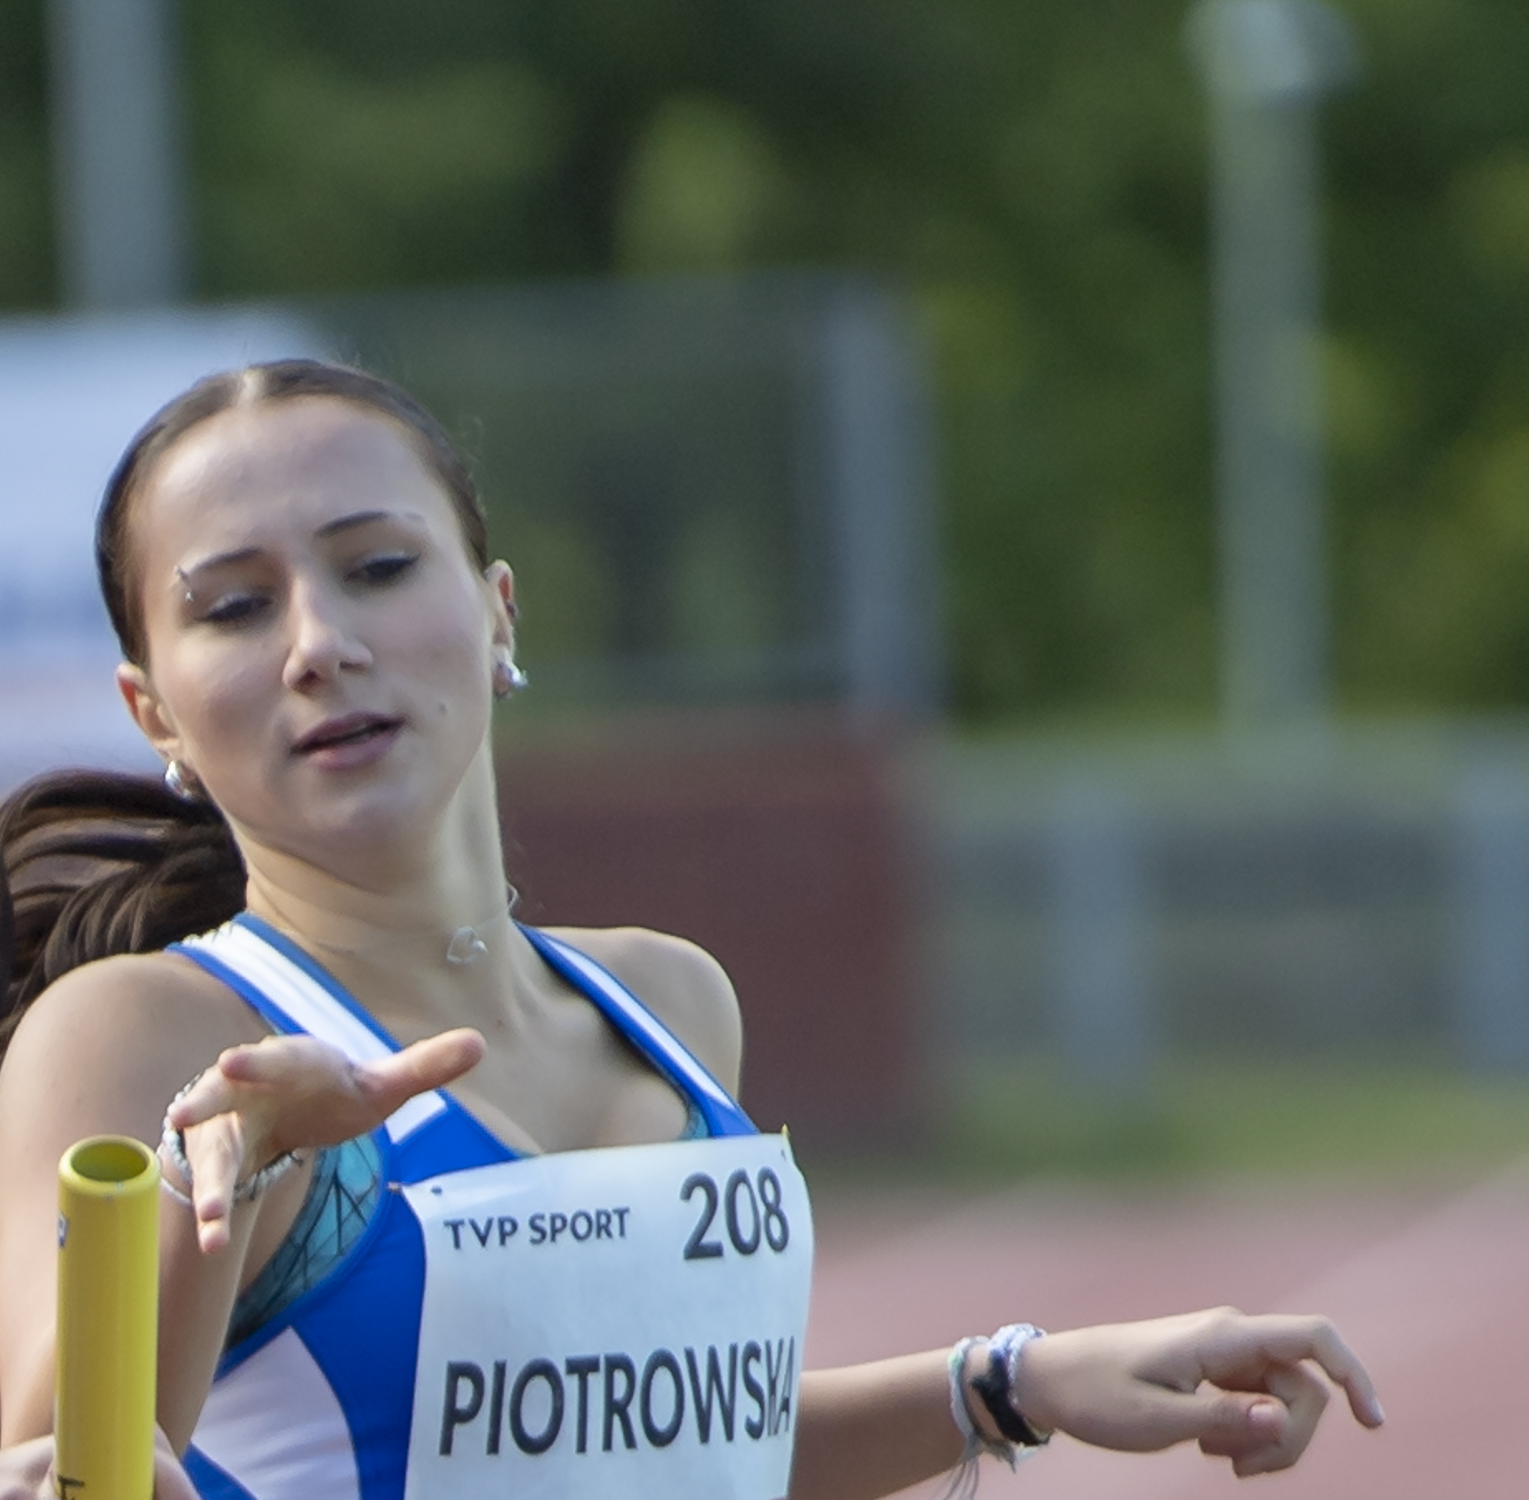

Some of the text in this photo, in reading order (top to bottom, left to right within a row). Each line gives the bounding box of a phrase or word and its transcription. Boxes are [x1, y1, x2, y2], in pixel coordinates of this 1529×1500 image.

[443, 1207, 631, 1250] TVP SPORT
[679, 1165, 790, 1261] 208
[438, 1335, 795, 1457] PIOTROWSKA
